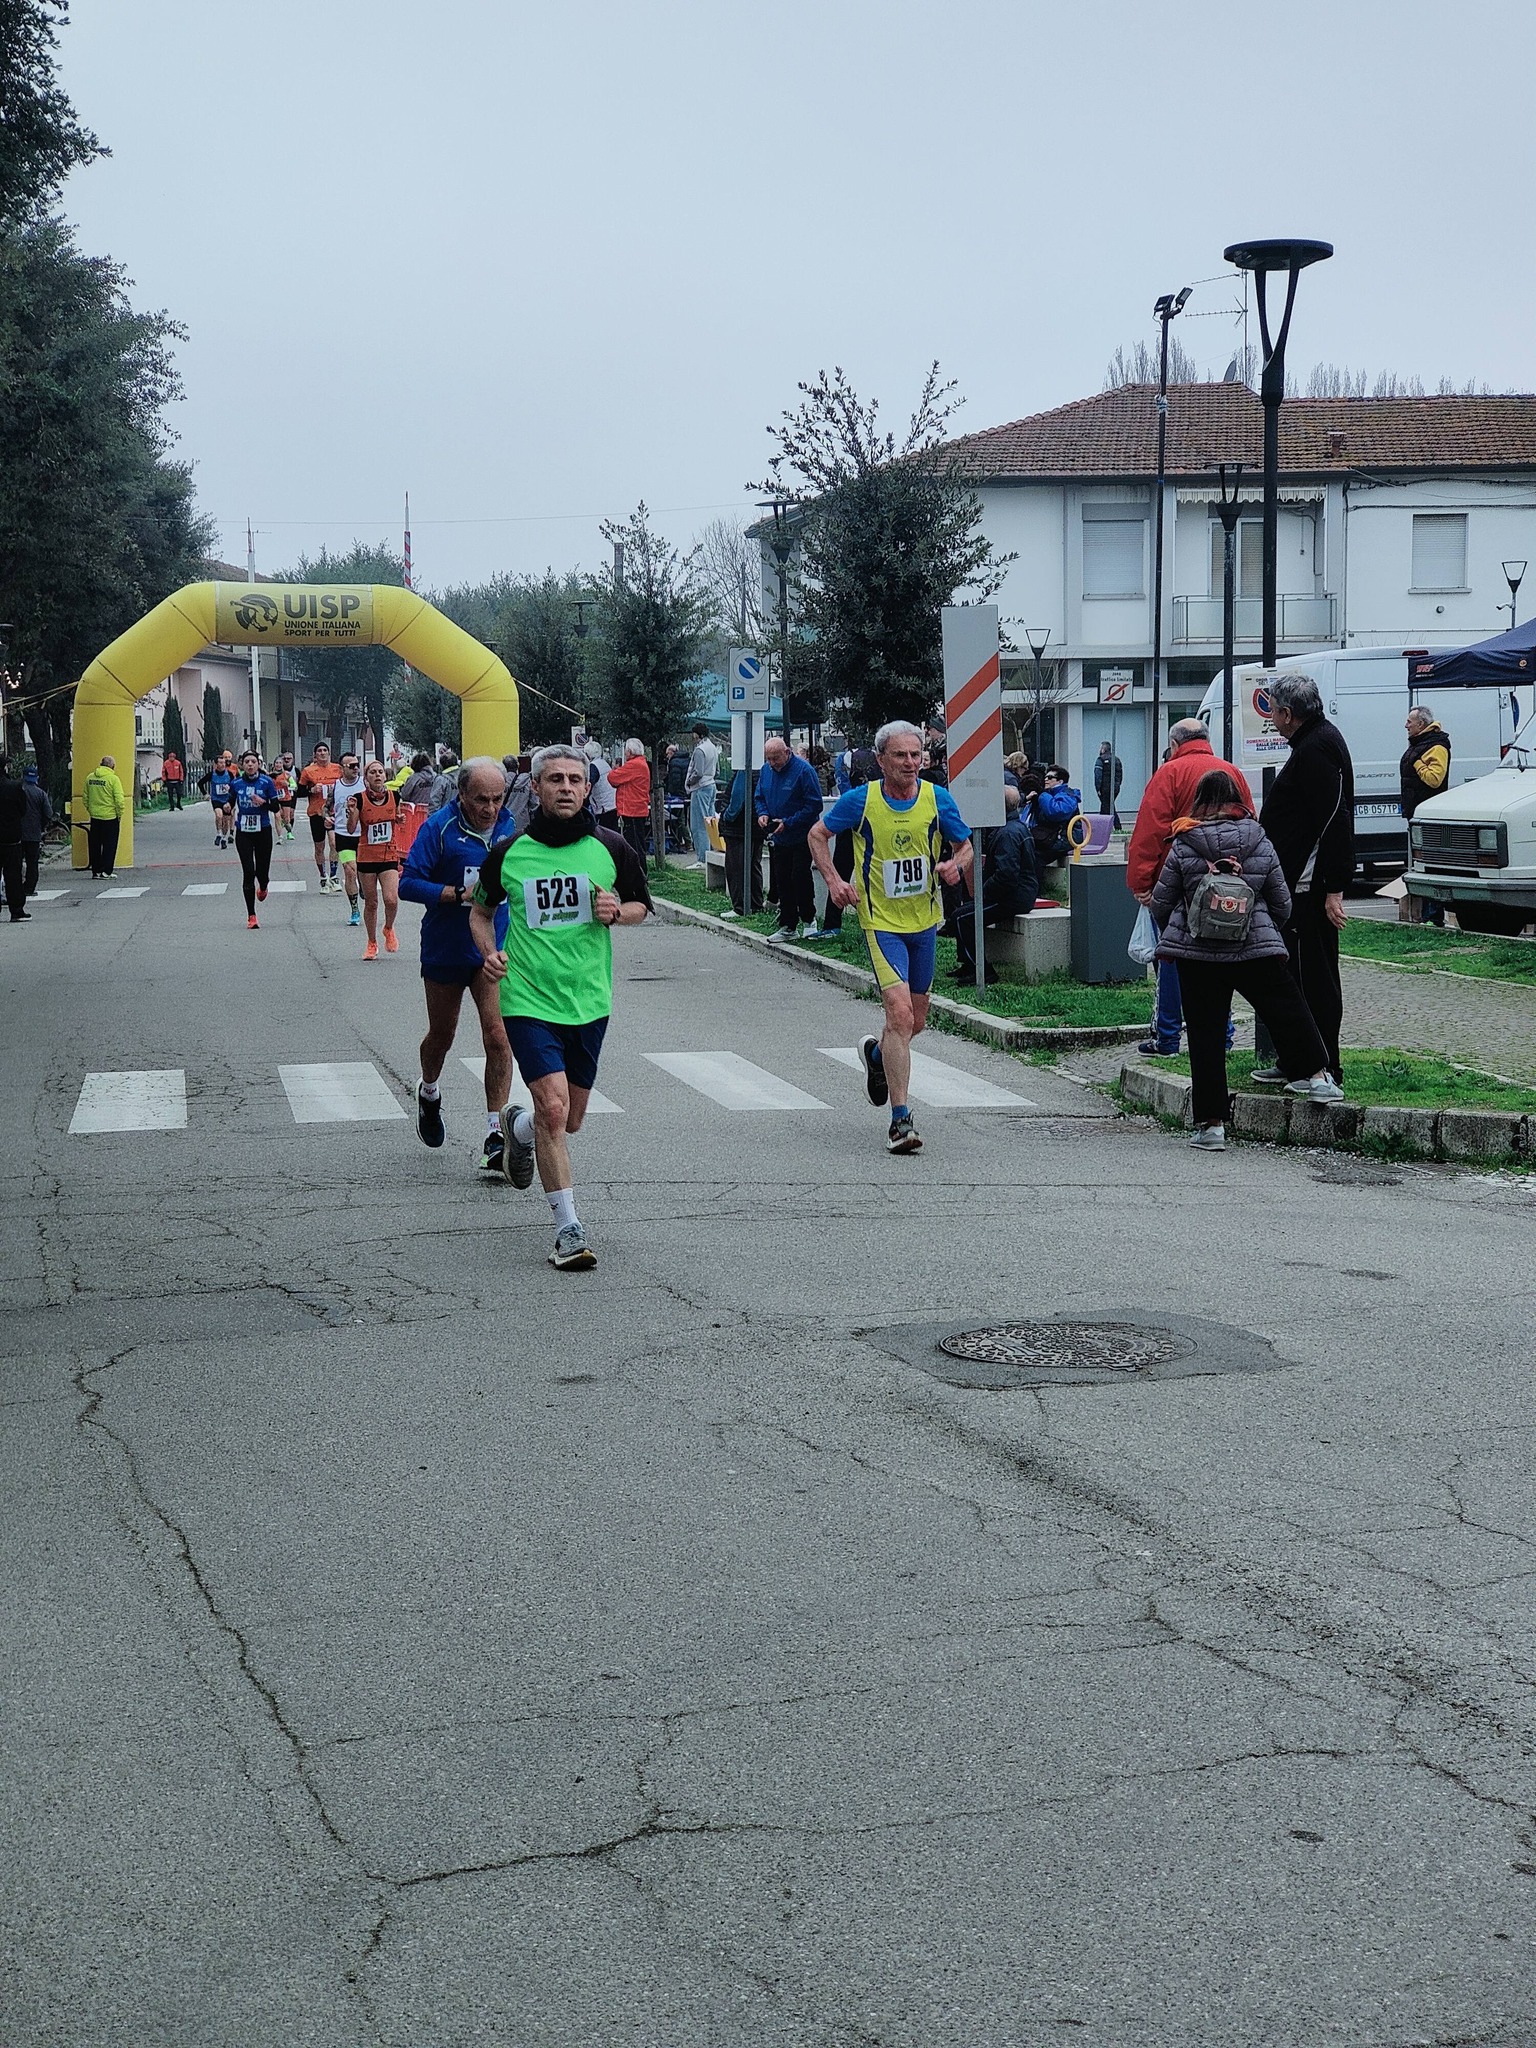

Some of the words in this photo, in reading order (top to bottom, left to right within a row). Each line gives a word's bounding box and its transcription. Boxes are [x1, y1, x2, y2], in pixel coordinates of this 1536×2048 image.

[284, 594, 360, 619] UISP
[284, 621, 318, 629] UNIONE
[322, 621, 360, 629] ITALIANA
[334, 629, 356, 637] TUTTI
[734, 688, 743, 698] P
[372, 823, 388, 838] 647
[893, 858, 923, 884] 798
[536, 877, 579, 910] 523
